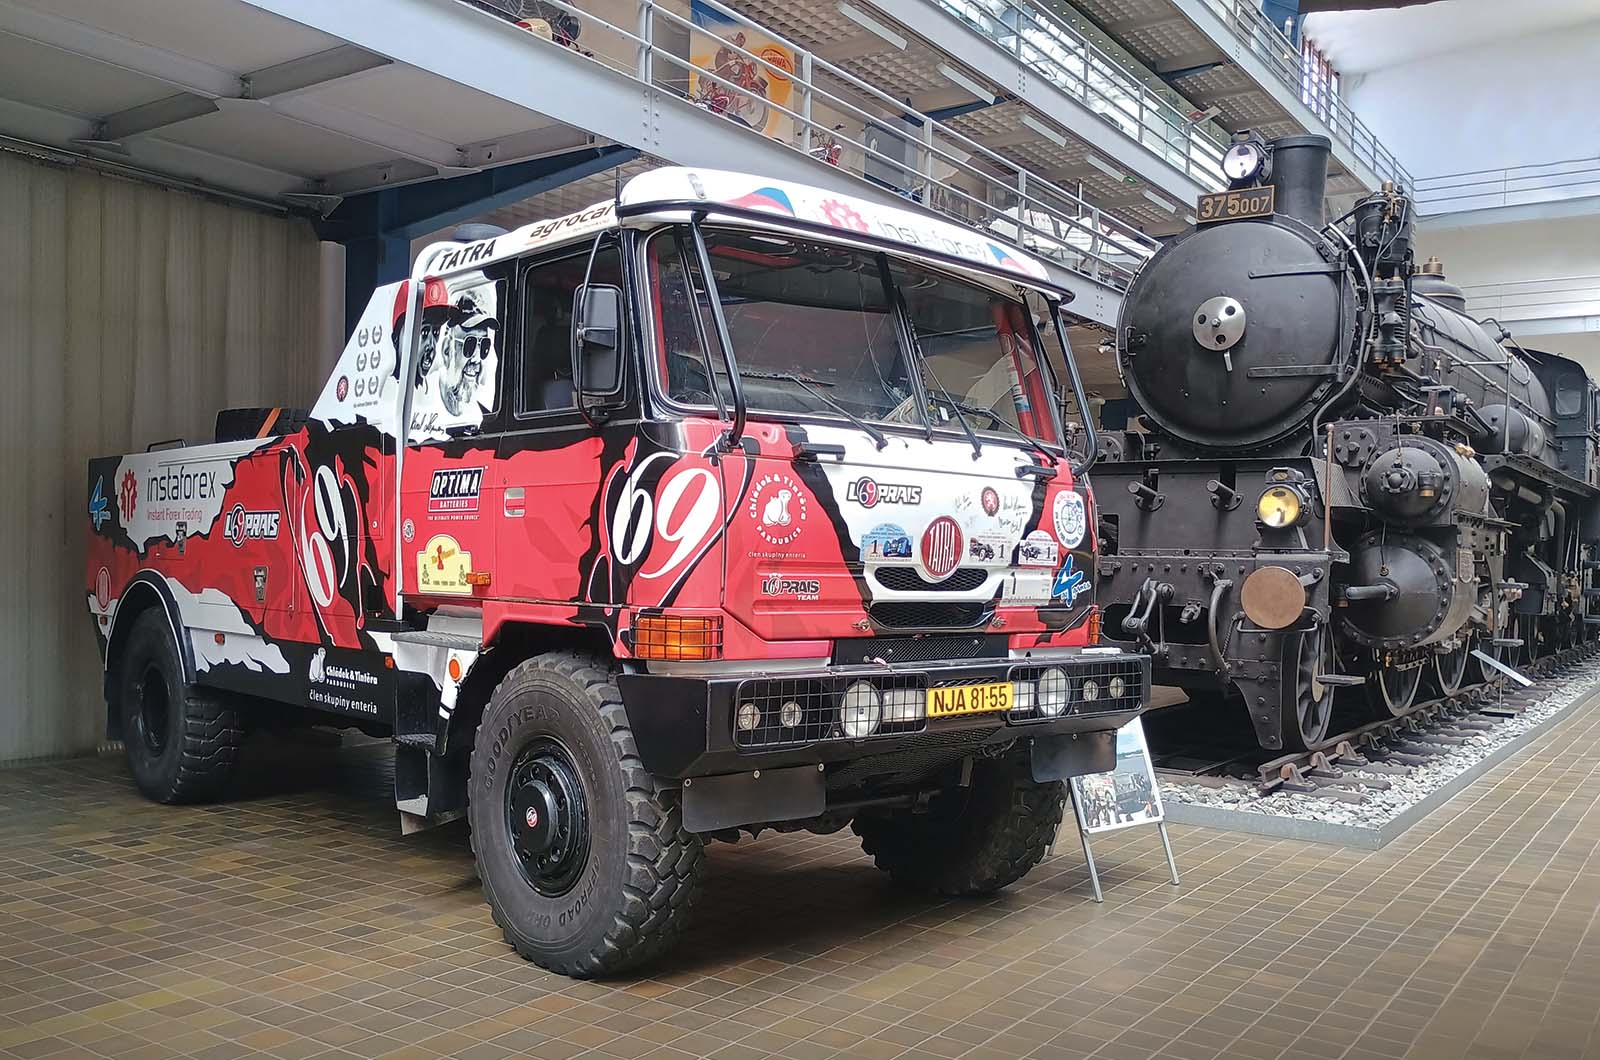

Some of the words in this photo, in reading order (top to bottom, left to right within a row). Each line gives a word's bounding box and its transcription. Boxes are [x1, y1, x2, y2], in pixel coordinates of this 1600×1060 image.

[530, 203, 615, 238] agrocar
[874, 215, 988, 260] instforex
[438, 239, 496, 271] TATRA
[147, 465, 217, 502] instaforex
[432, 473, 479, 496] OPTIMA
[147, 508, 165, 521] Instant
[166, 507, 181, 521] Forex
[182, 507, 203, 523] Trading
[440, 499, 469, 509] BATTERIES
[613, 452, 720, 579] 69
[928, 521, 956, 573] TATRA
[309, 689, 324, 702] člen
[324, 692, 351, 711] skupiny
[350, 700, 378, 714] enteria
[934, 689, 966, 713] NJA
